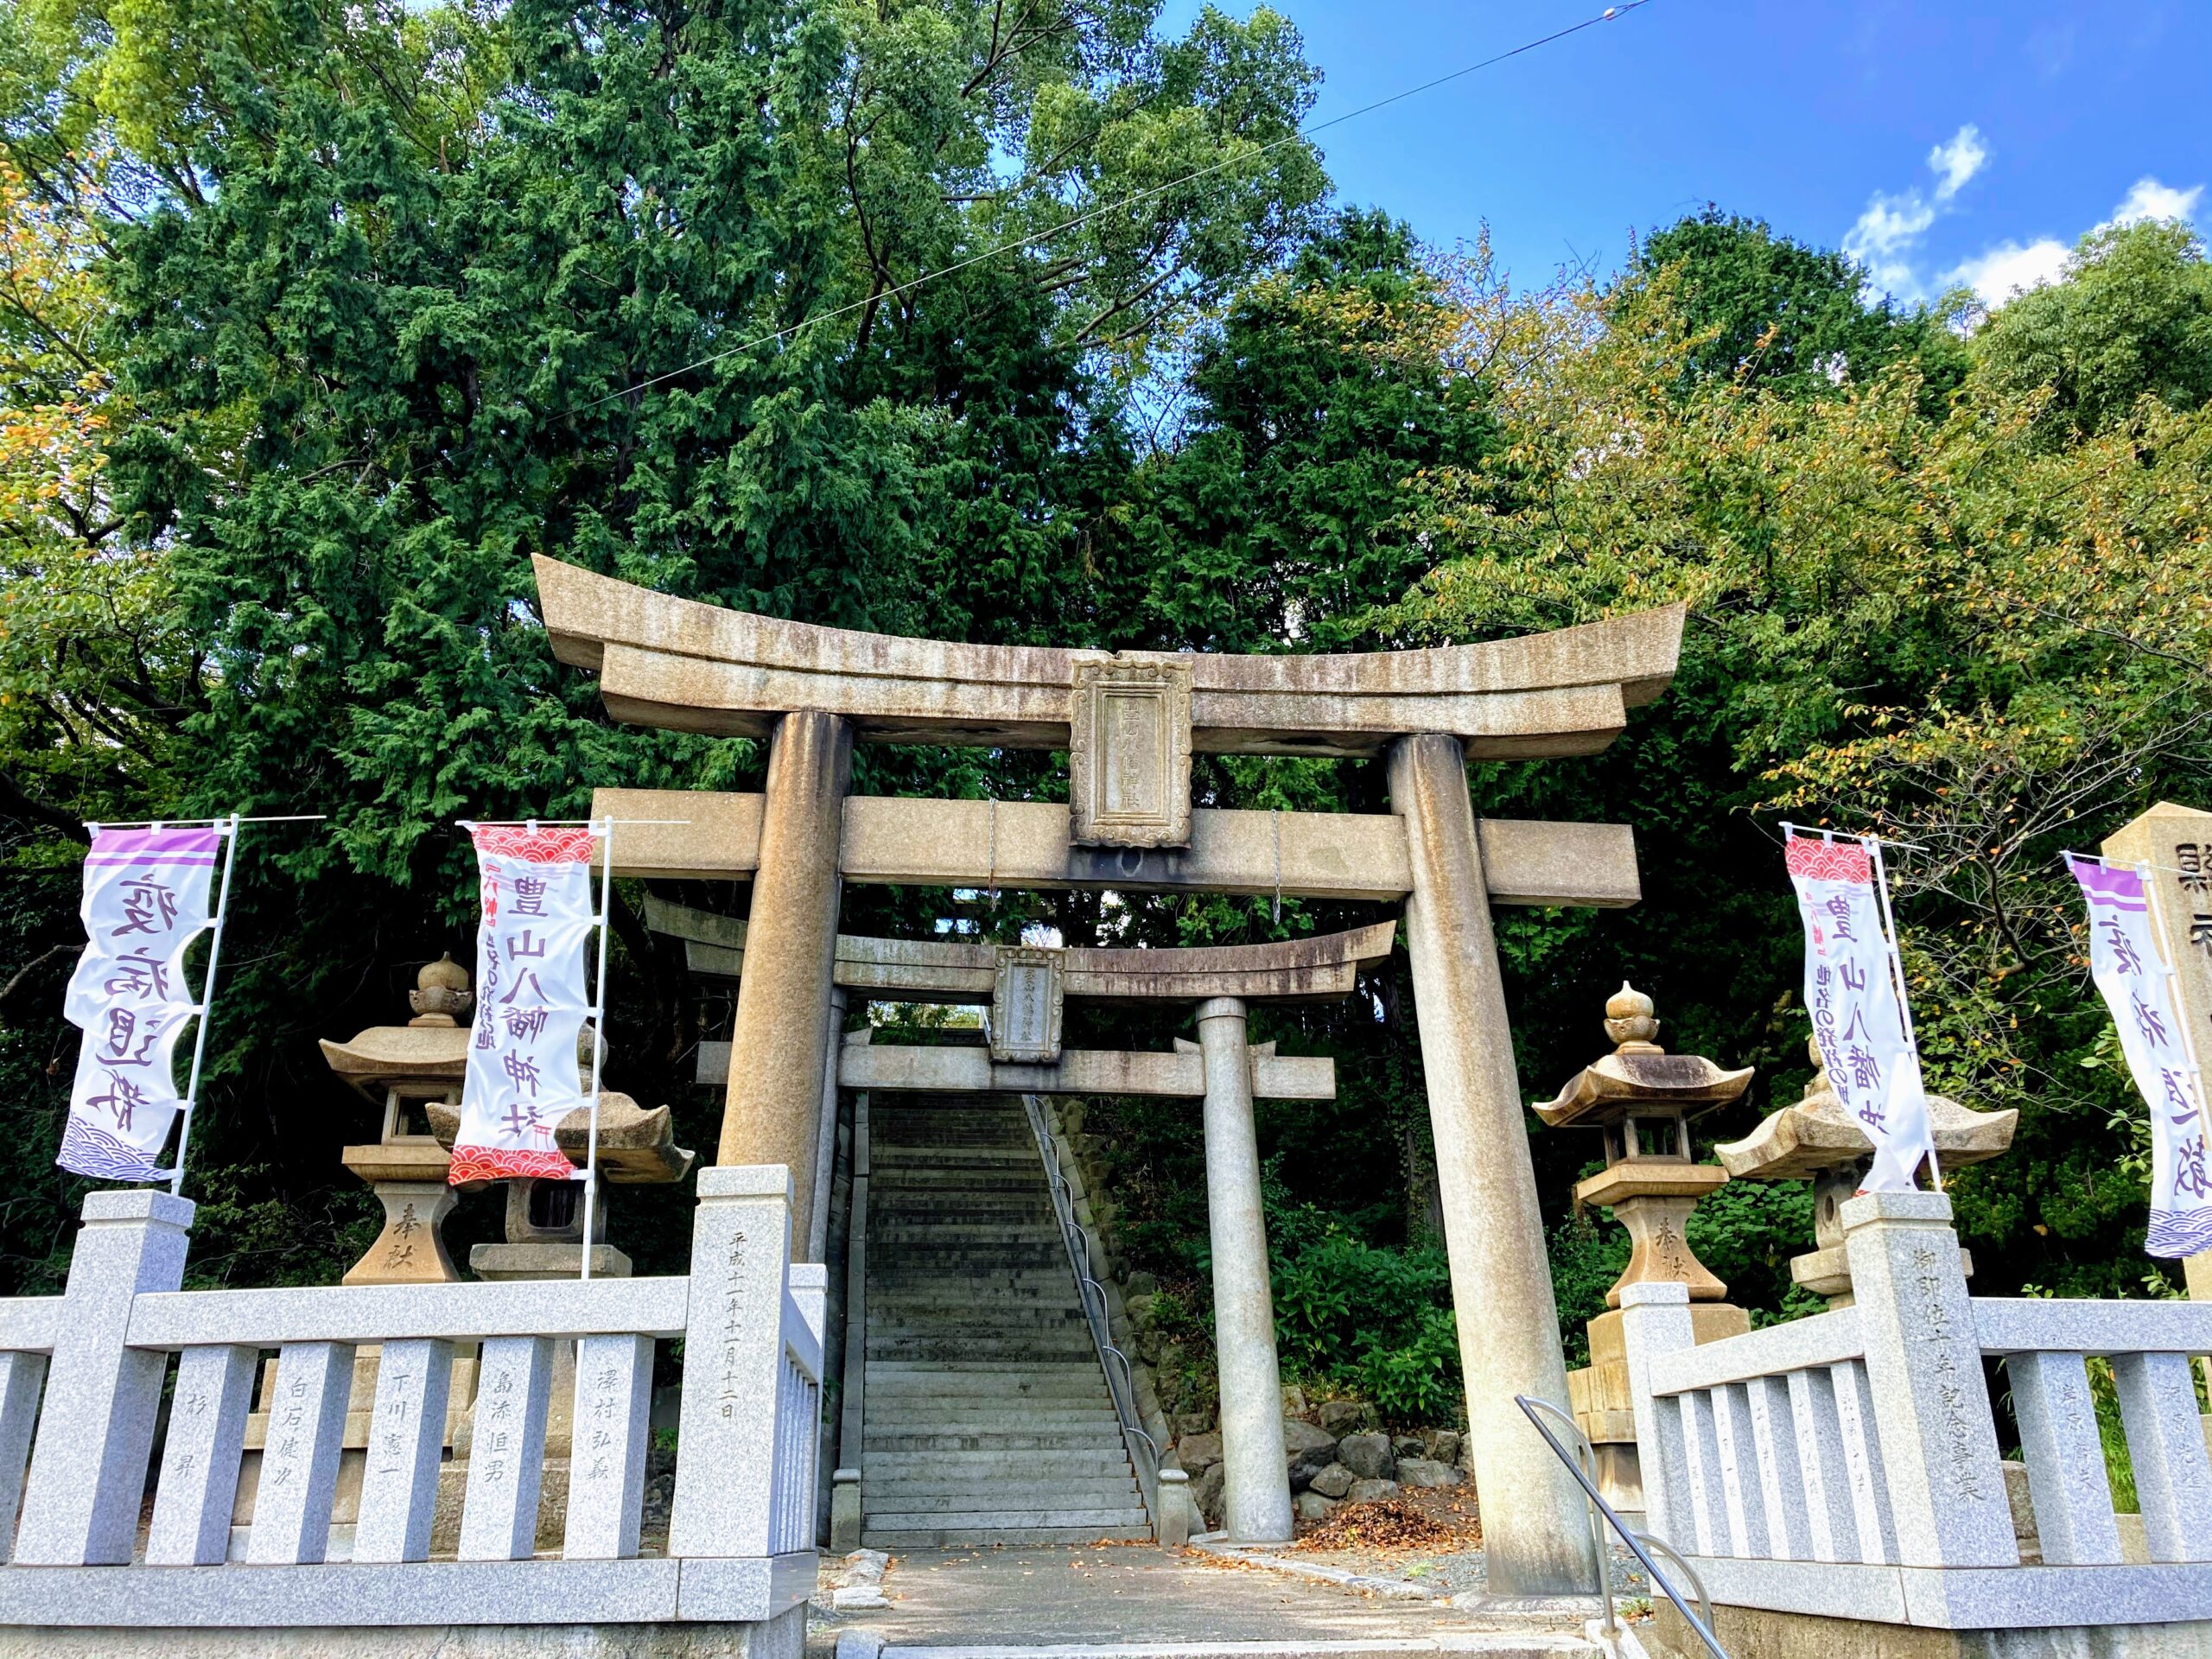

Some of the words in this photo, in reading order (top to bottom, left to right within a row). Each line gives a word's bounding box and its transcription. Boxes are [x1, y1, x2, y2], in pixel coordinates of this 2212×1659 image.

[719, 1231, 747, 1420] 平成十一年十一月十二日
